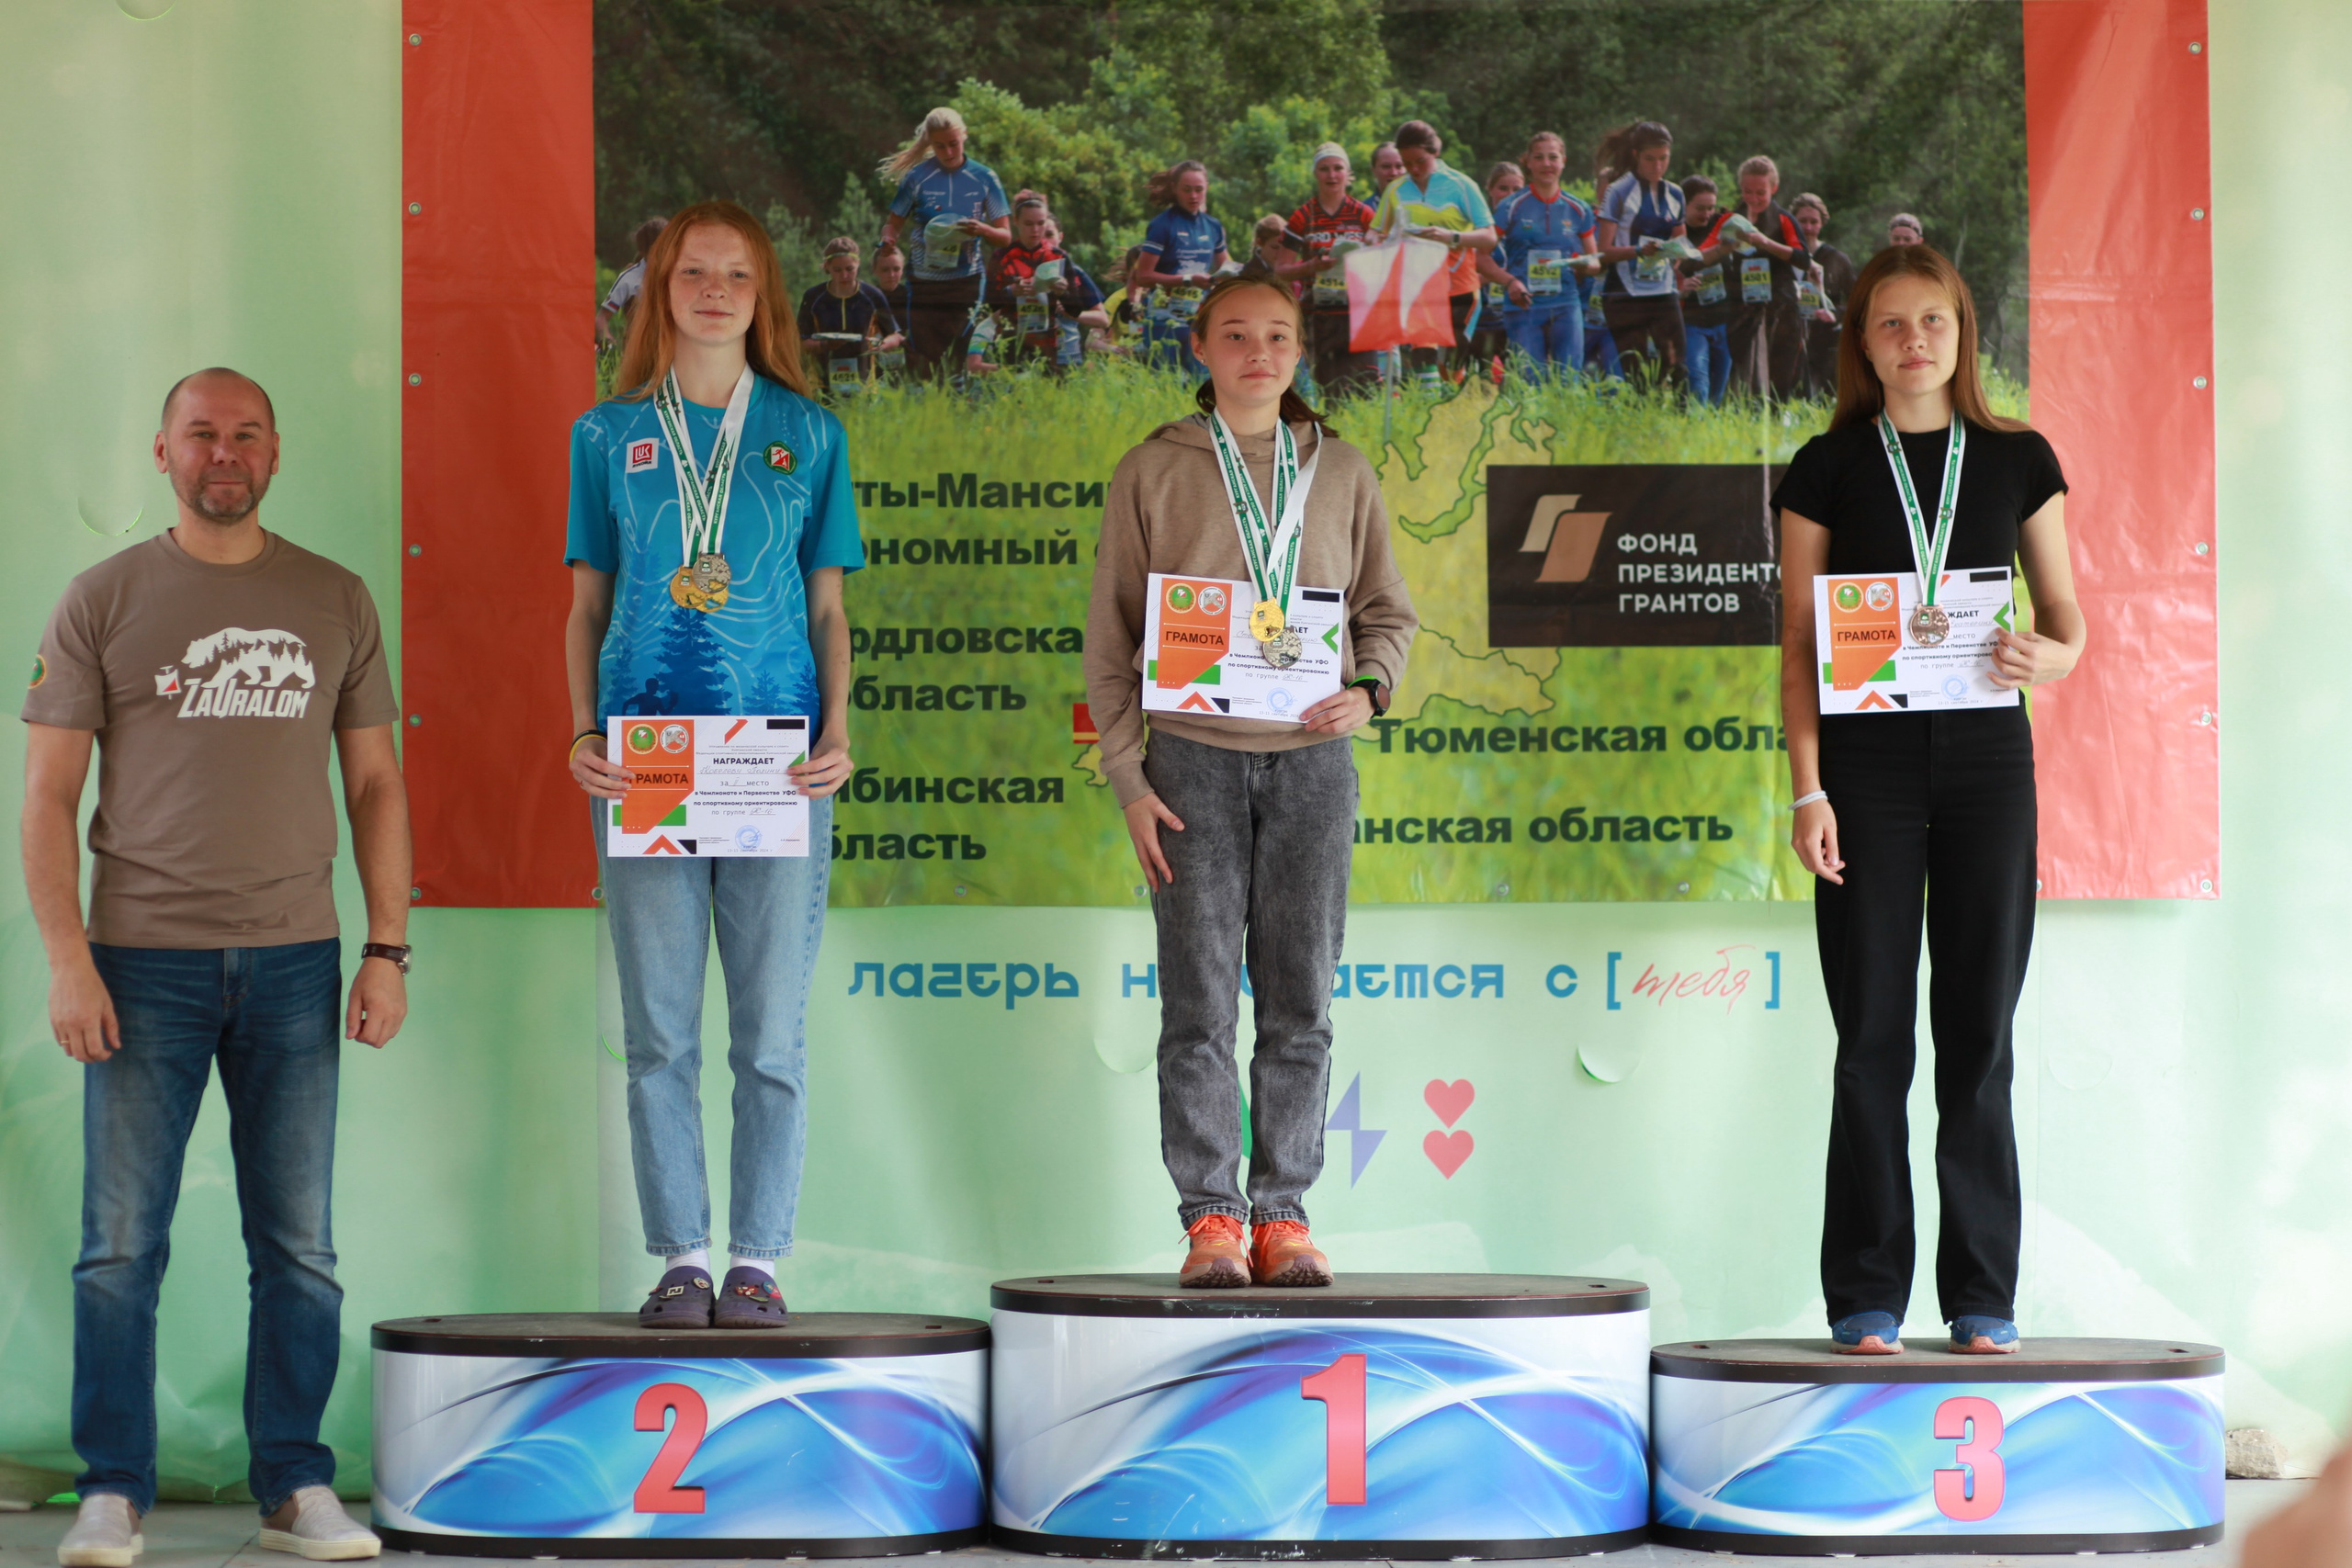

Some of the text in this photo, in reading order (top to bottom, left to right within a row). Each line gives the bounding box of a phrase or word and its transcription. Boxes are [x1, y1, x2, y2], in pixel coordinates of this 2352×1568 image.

[663, 411, 684, 456] КУРГАНСКАЯ ОБЛАСТЬ
[635, 445, 650, 461] LUK
[851, 473, 1111, 508] ты-Манси
[1222, 448, 1240, 499] КУРГАНСКАЯ ОБЛАСТЬ
[687, 471, 699, 499] КУРГАНСКАЯ
[697, 499, 707, 522] ОБЛАСТЬ
[714, 494, 723, 524] КУРГАНСКАЯ
[862, 529, 1077, 565] номный
[1242, 516, 1259, 570] КУРГАНСКАЯ ОБЛАСТЬ
[1617, 533, 1698, 556] ФОНД
[1283, 563, 1292, 595] КУРГАНСКАЯ
[1618, 563, 1781, 585] ПРЕЗИДЕНТ
[1619, 593, 1740, 613] ГРАНТОВ
[1948, 610, 1979, 618] ЖДАЕТ
[849, 626, 1083, 661] рдловска
[1166, 631, 1225, 645] ГРАМОТА
[1838, 630, 1896, 641] ГРАМОТА
[847, 675, 1026, 710] бласть
[1370, 718, 1666, 753] Тюменская
[713, 757, 775, 765] НАГРАЖДАЕТ
[1352, 807, 1734, 843] нская область
[848, 963, 1080, 1010] лагерь
[1545, 964, 1577, 998] с
[1301, 1353, 1367, 1506] 1
[634, 1382, 707, 1514] 2
[1933, 1396, 2006, 1522] 3
